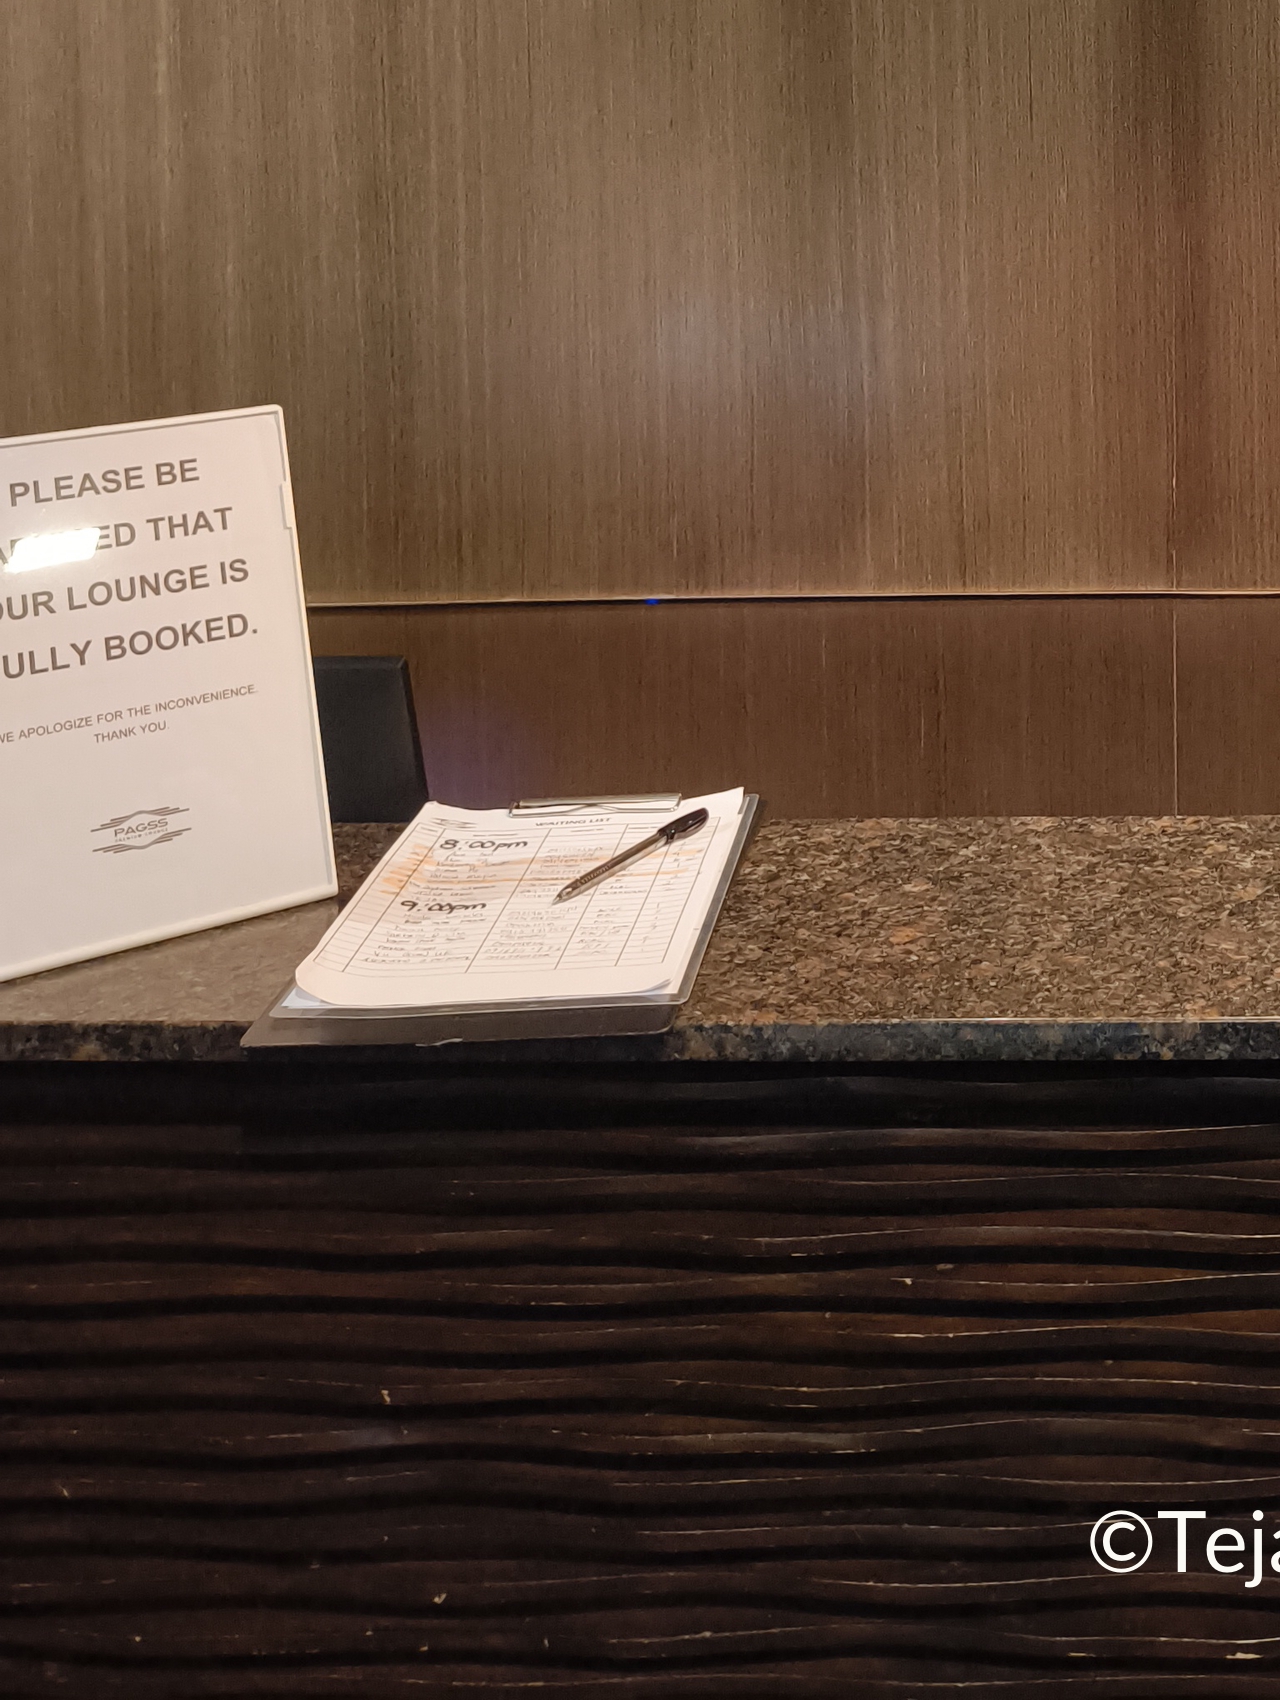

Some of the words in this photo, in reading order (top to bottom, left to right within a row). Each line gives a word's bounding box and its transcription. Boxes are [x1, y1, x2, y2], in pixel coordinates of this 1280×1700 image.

[9, 465, 146, 507] PLEASE
[155, 458, 200, 487] BE
[146, 506, 233, 541] THAT
[0, 590, 56, 620] UR
[66, 564, 210, 611] LOUNGE
[219, 558, 249, 585] IS
[104, 613, 258, 661] BOOKED.
[18, 716, 93, 740] APOLOGIZE
[97, 710, 124, 724] FOR
[127, 704, 151, 719] THE
[155, 684, 258, 713] INCONVENIENCE.
[93, 727, 137, 744] THANK
[140, 720, 170, 735] YOU.
[114, 817, 168, 837] PAGSS
[536, 818, 586, 827] WAITING
[440, 839, 528, 852] 8:00pm
[401, 900, 487, 915] 9:00pm
